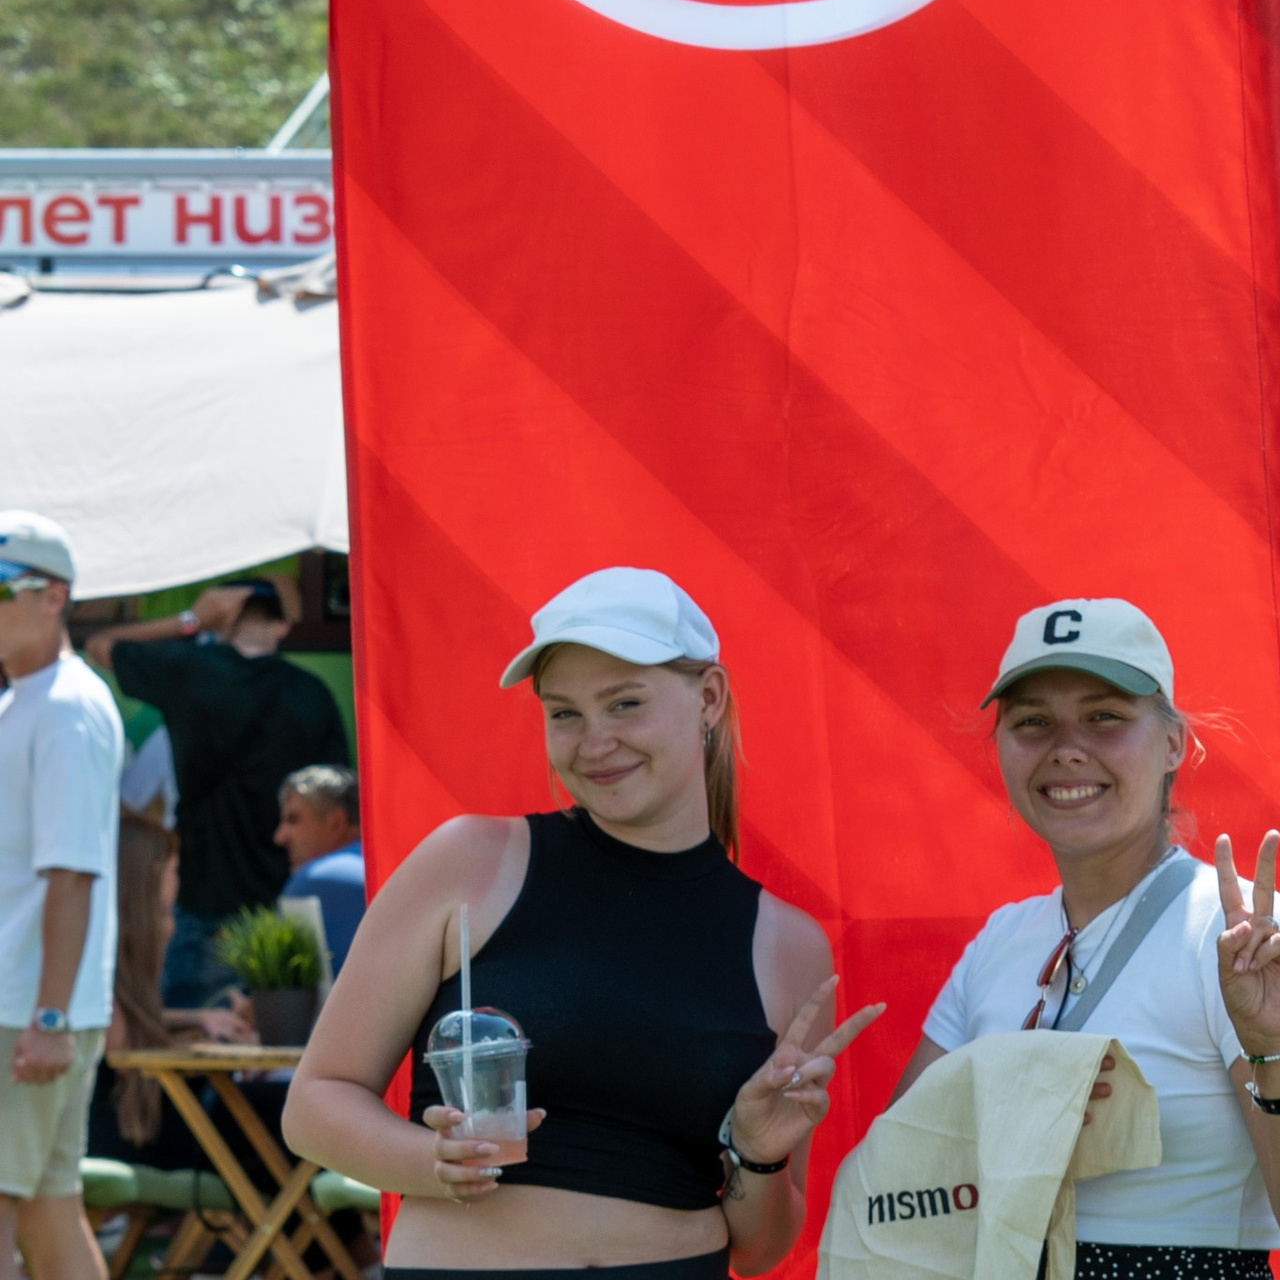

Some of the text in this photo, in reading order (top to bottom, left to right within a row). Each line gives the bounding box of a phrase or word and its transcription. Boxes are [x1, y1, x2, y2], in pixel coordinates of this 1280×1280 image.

[173, 193, 332, 247] низ
[1043, 609, 1082, 645] C
[867, 1182, 979, 1226] nismo
